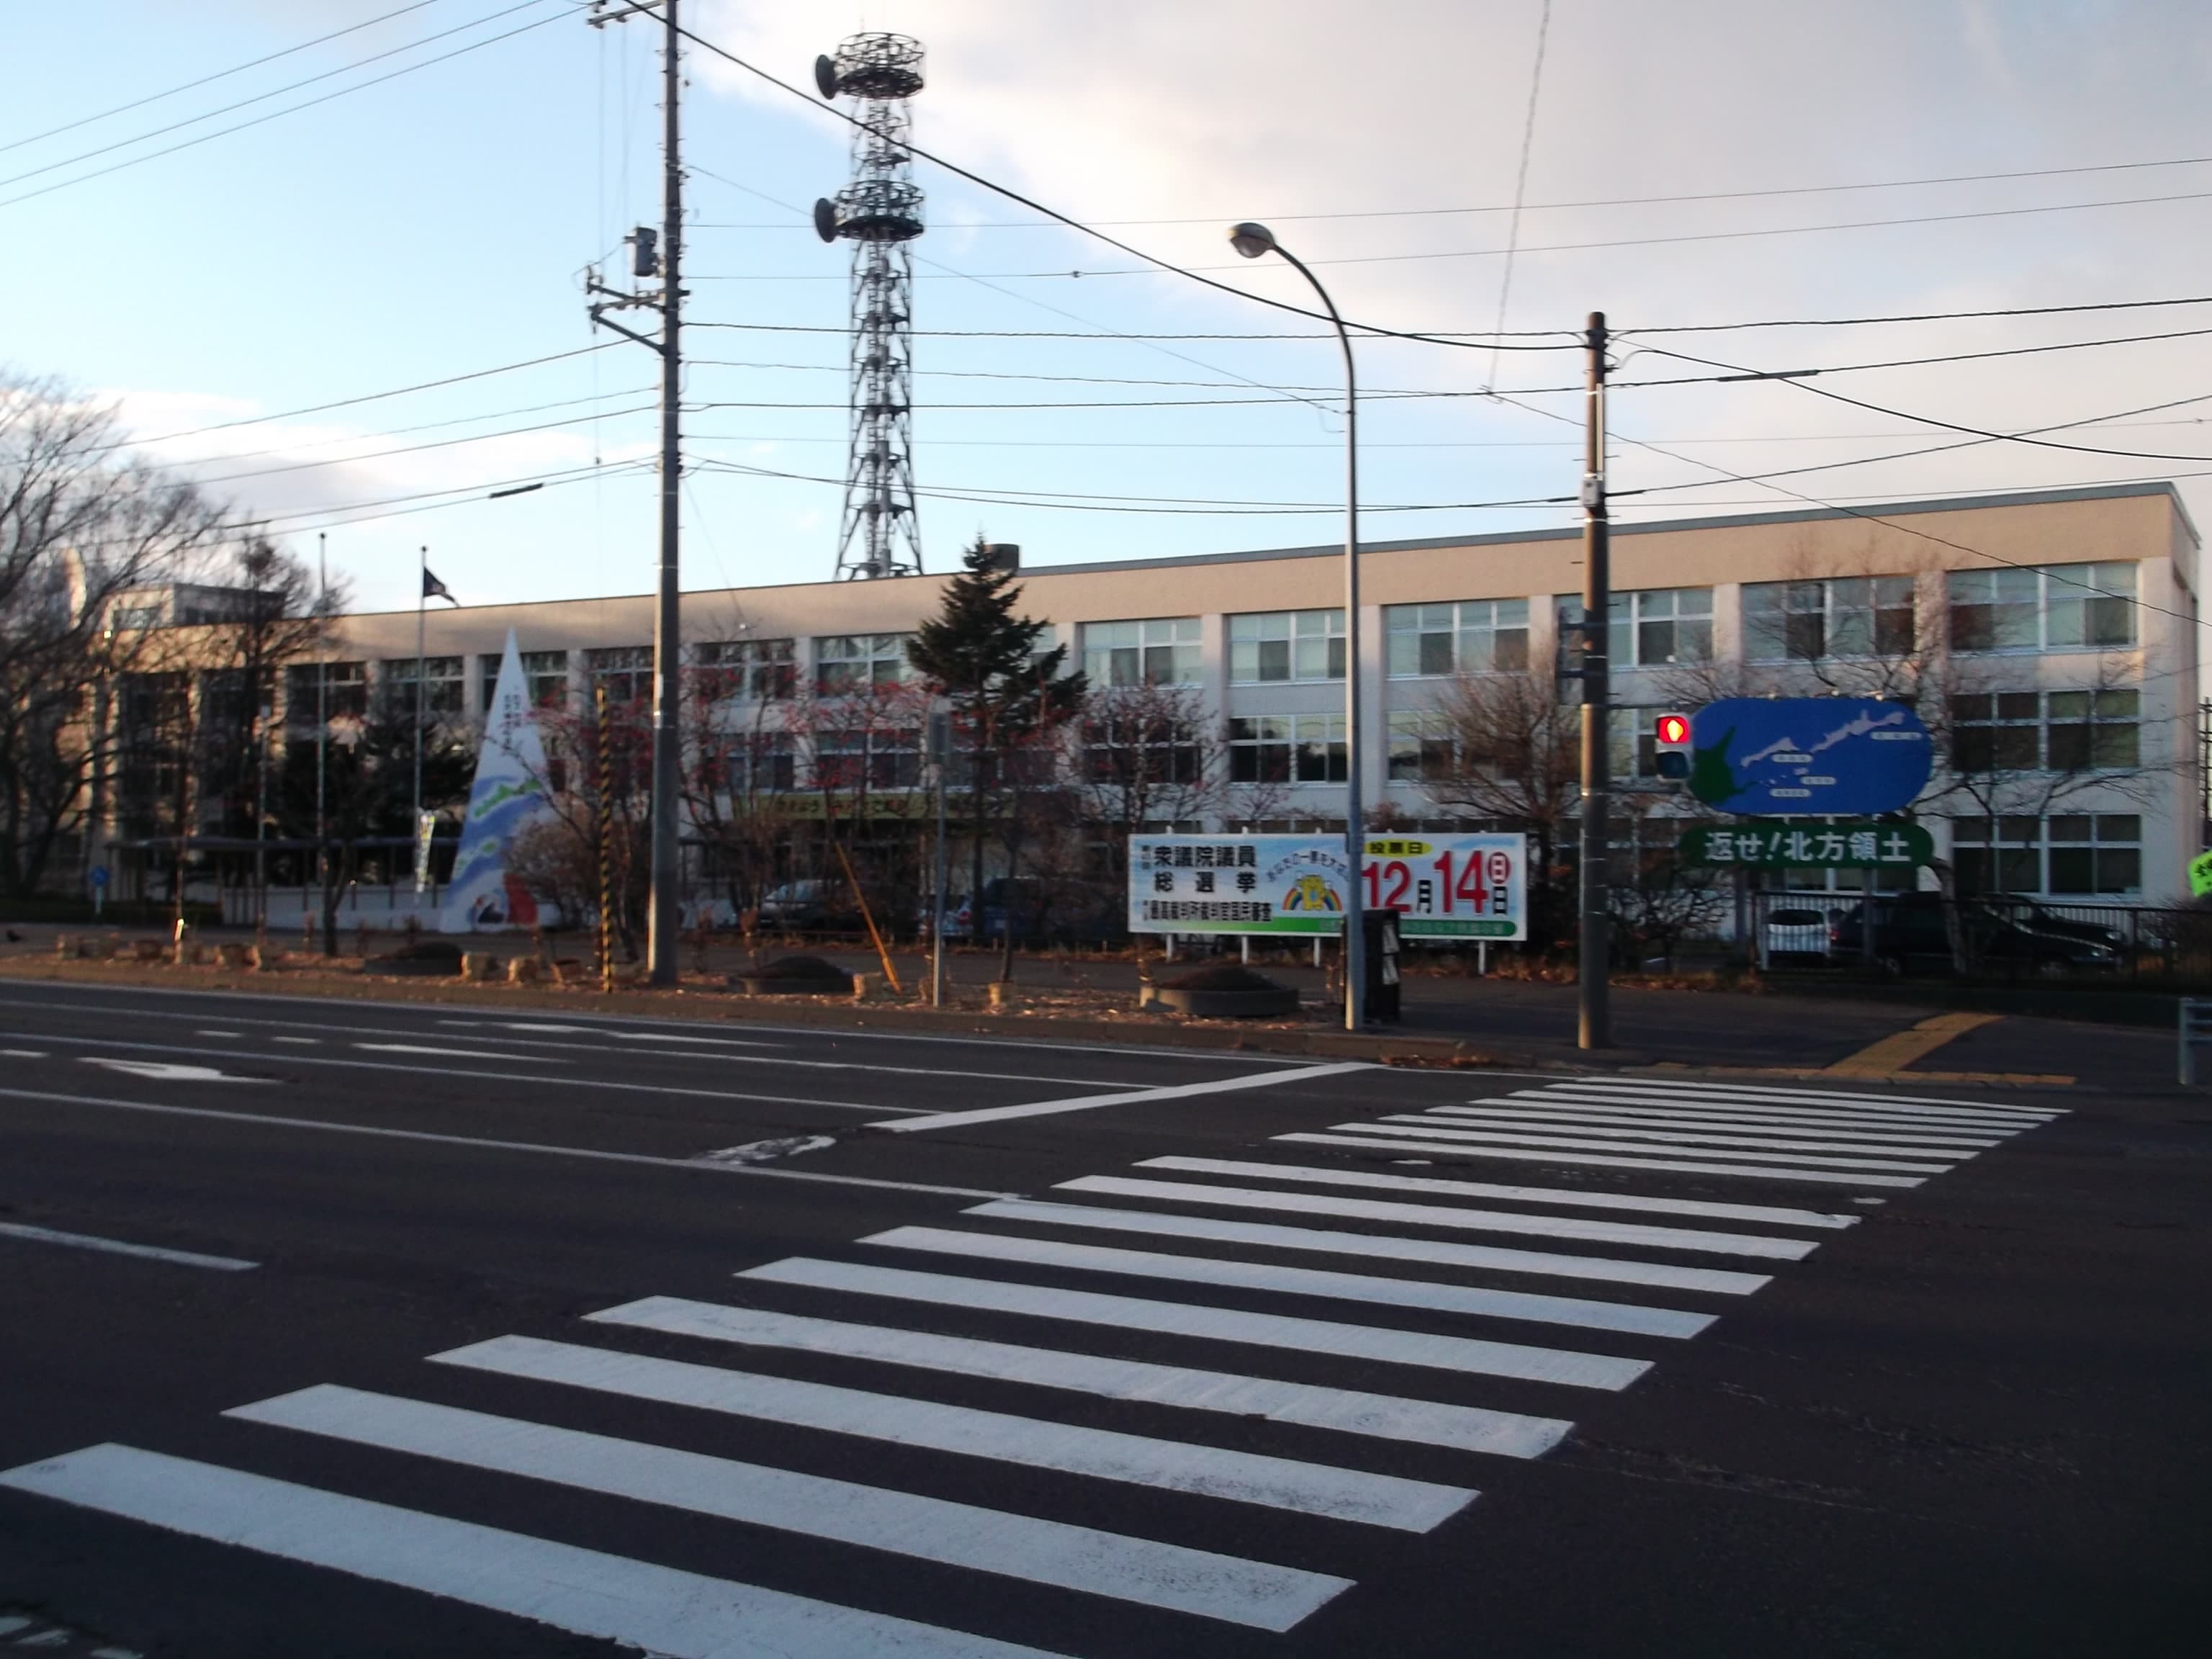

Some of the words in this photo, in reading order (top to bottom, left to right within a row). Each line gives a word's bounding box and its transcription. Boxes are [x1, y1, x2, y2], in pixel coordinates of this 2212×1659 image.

[1154, 845, 1256, 867] 衆議院議員
[1370, 842, 1423, 854] 投票日
[1704, 831, 1911, 862] 返せ!北方領土
